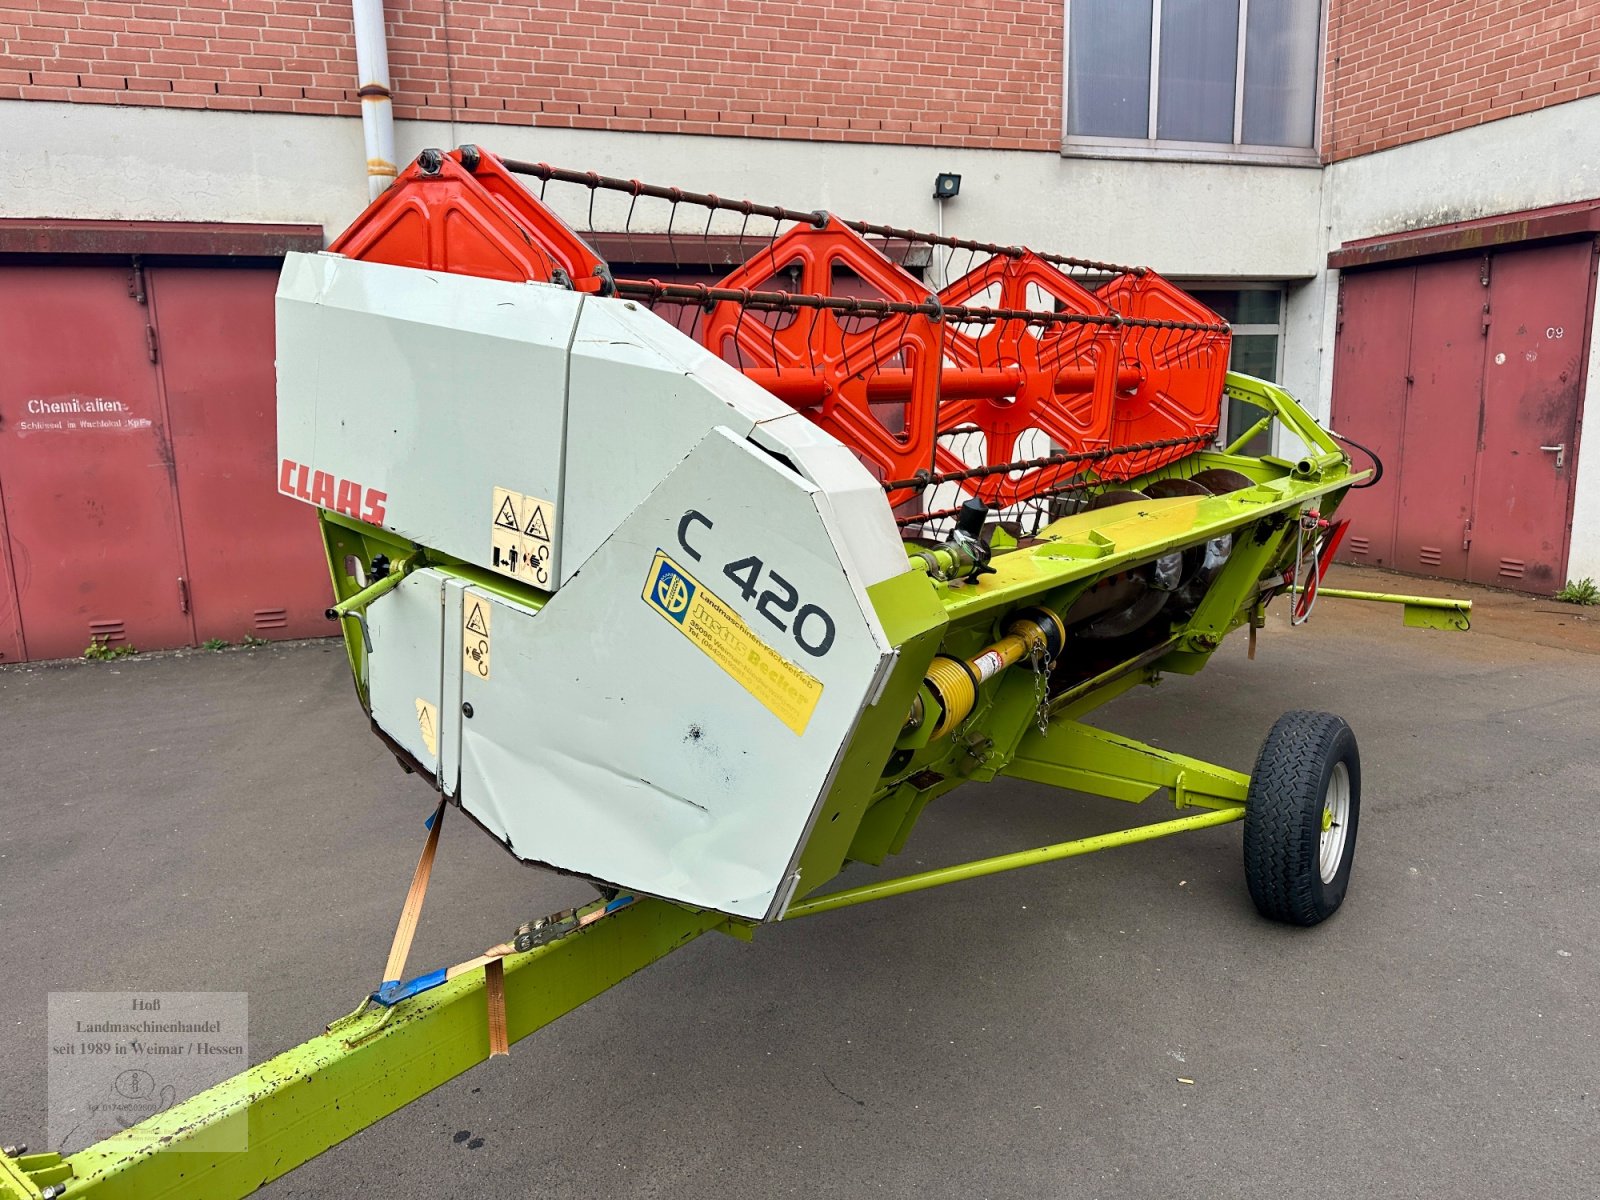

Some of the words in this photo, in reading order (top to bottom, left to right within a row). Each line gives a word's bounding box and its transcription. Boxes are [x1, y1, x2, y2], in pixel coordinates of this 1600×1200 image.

[27, 398, 122, 415] Chemikalien
[279, 459, 388, 527] CLAAS
[677, 509, 714, 562] C
[723, 555, 836, 657] 420
[691, 601, 749, 658] Justus
